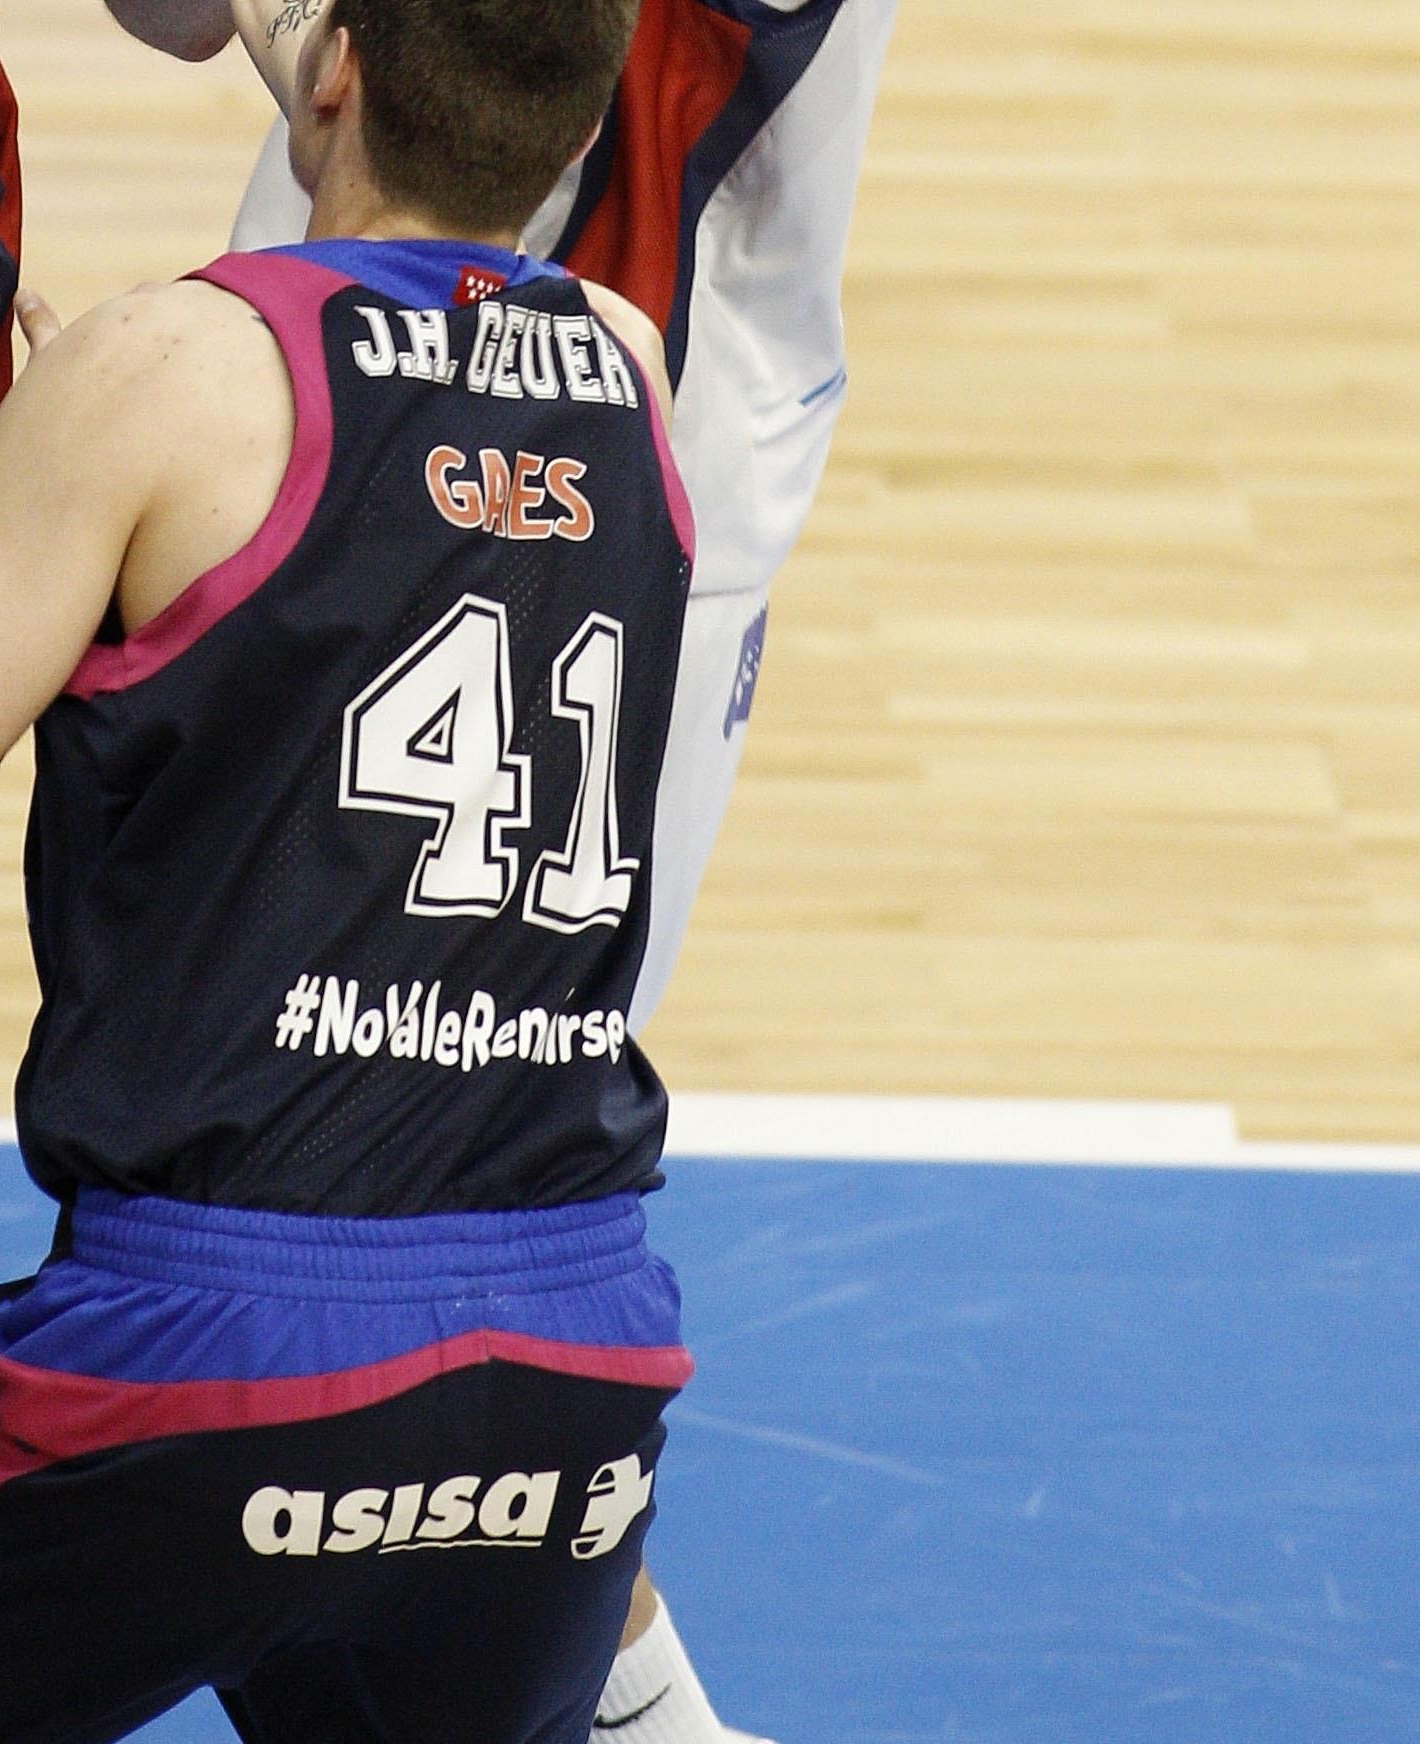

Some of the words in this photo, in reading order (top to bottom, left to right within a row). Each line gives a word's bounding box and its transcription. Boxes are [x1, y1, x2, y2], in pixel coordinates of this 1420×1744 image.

[425, 444, 595, 542] GAES
[338, 592, 640, 935] 41
[241, 1470, 561, 1557] asisa
